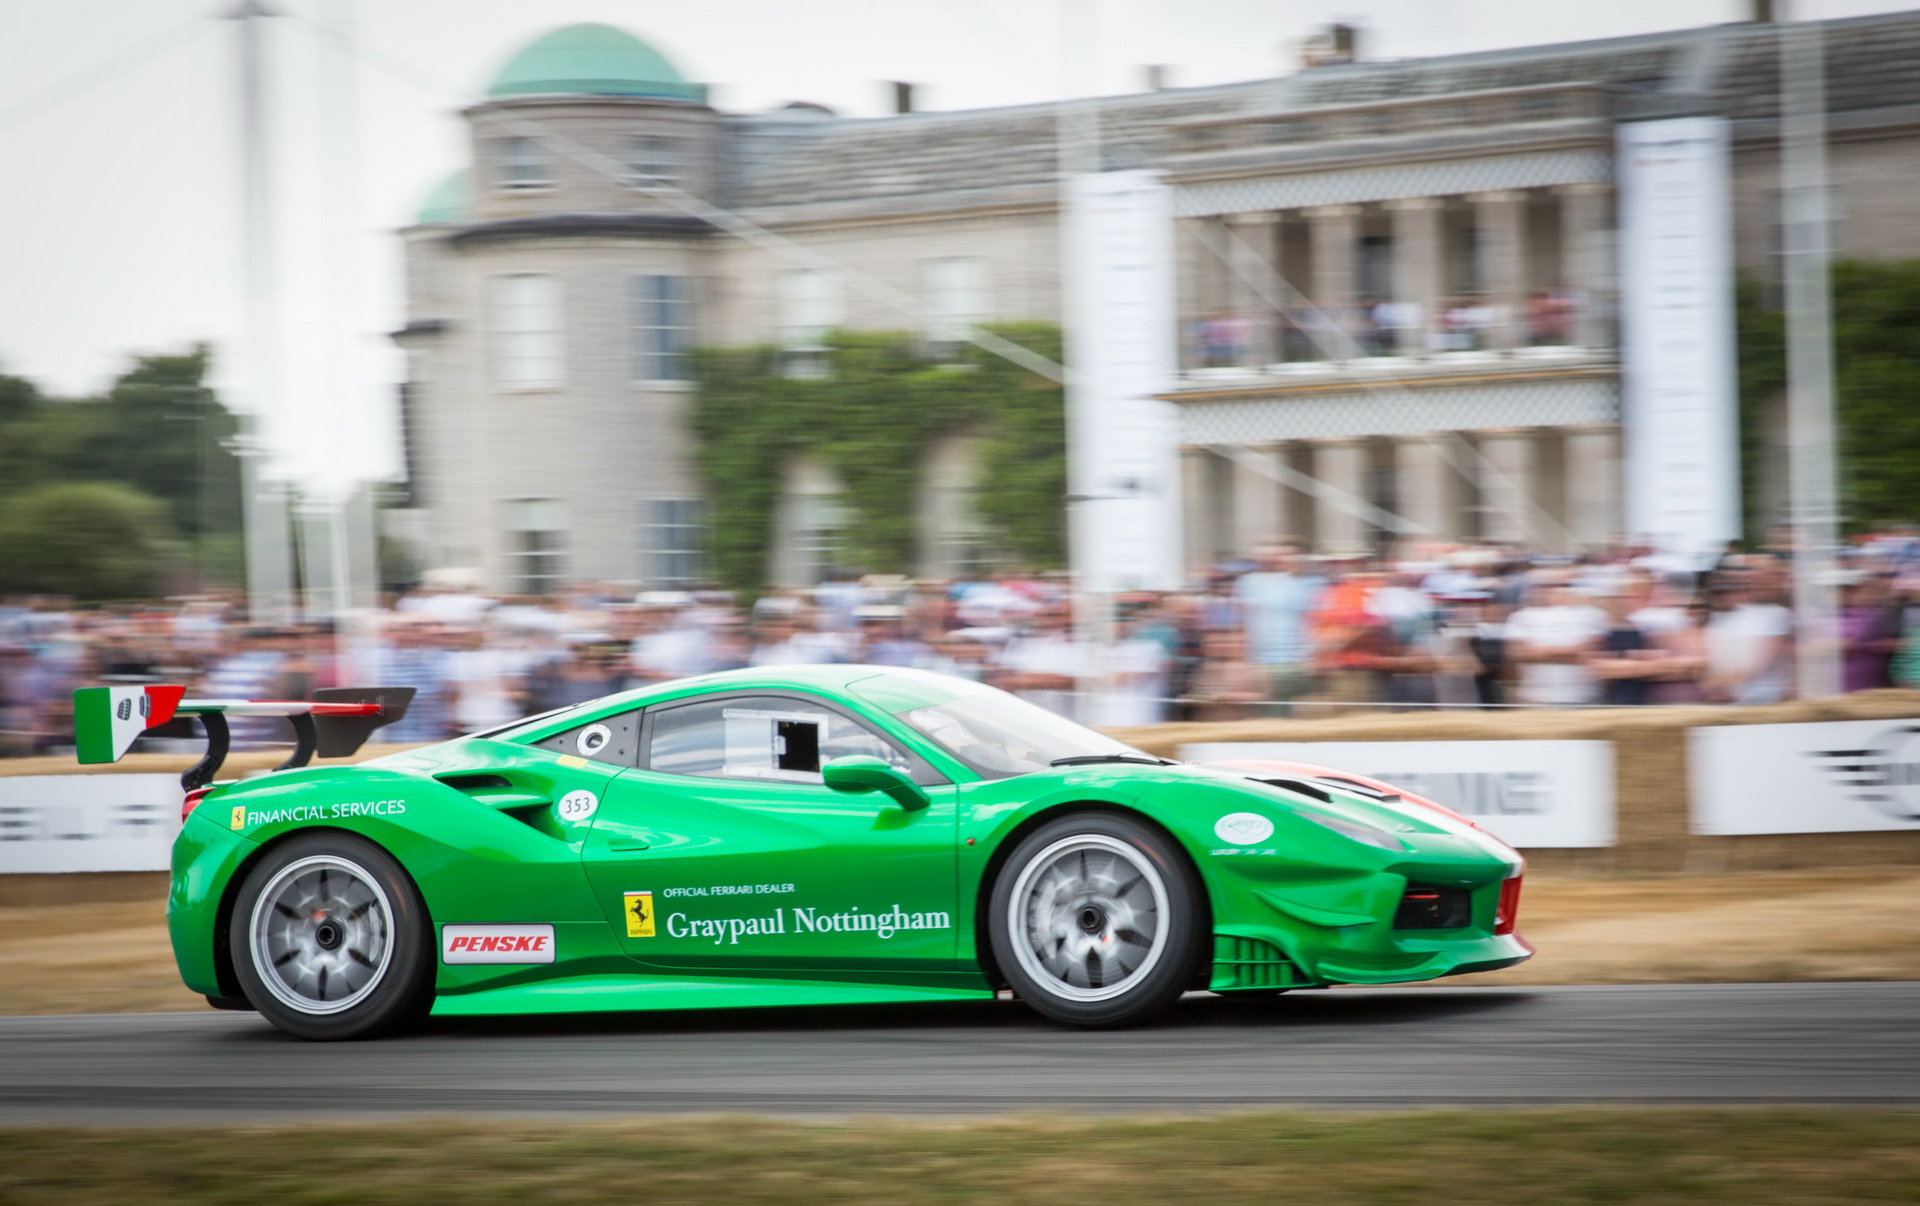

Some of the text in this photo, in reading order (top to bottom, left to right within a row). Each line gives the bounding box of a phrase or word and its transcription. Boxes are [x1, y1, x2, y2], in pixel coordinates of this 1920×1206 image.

[247, 800, 406, 825] FINANCIAL SERVICES
[565, 797, 590, 814] 353
[663, 883, 796, 898] OFFICIAL FERRARI DEALER
[666, 904, 952, 945] Graypaul Nottingham
[448, 936, 549, 952] PENSKE
